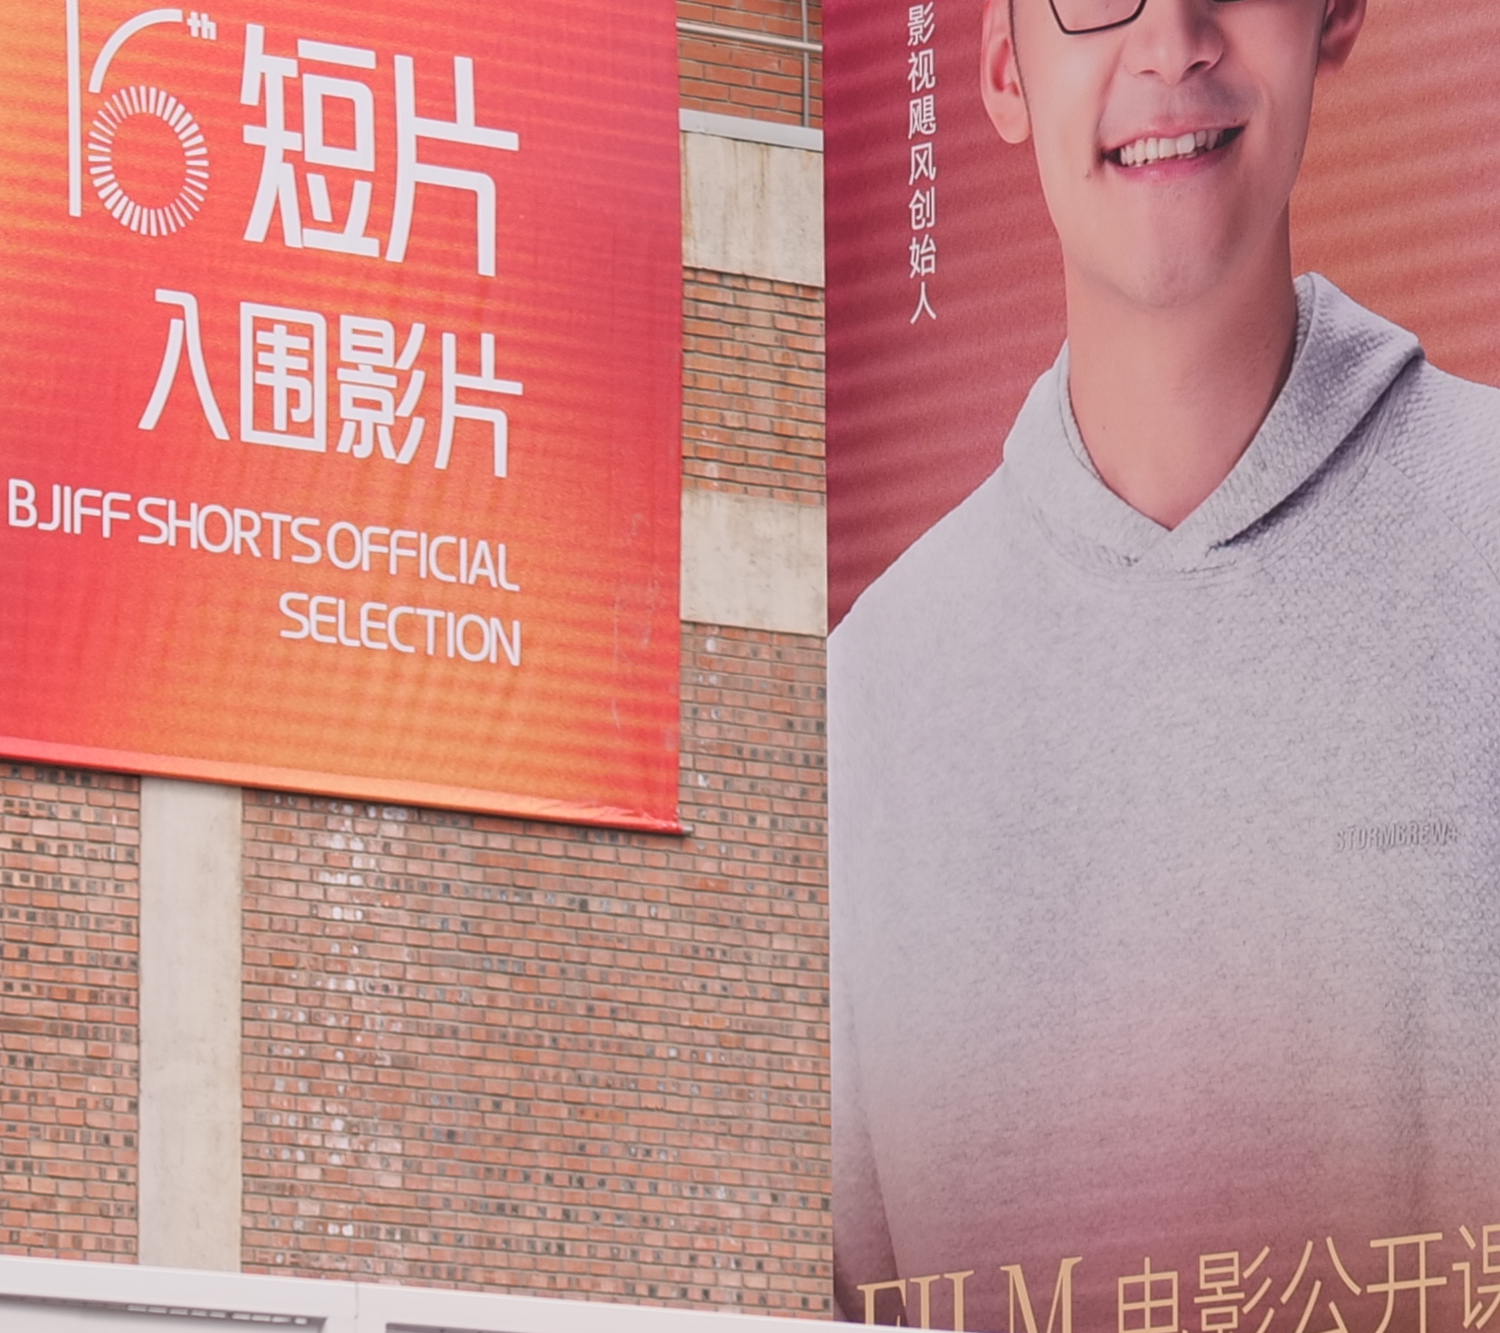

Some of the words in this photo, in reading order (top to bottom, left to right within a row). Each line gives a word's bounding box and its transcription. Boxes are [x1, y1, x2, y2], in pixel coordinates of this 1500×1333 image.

[239, 23, 520, 277] 短片
[906, 2, 937, 326] 影视飓风创始人
[138, 288, 523, 478] 入围影片
[9, 479, 132, 540] BJIFF
[137, 495, 320, 566] SHORTS
[327, 520, 519, 592] OFFICIAL
[279, 592, 522, 667] SELECTION
